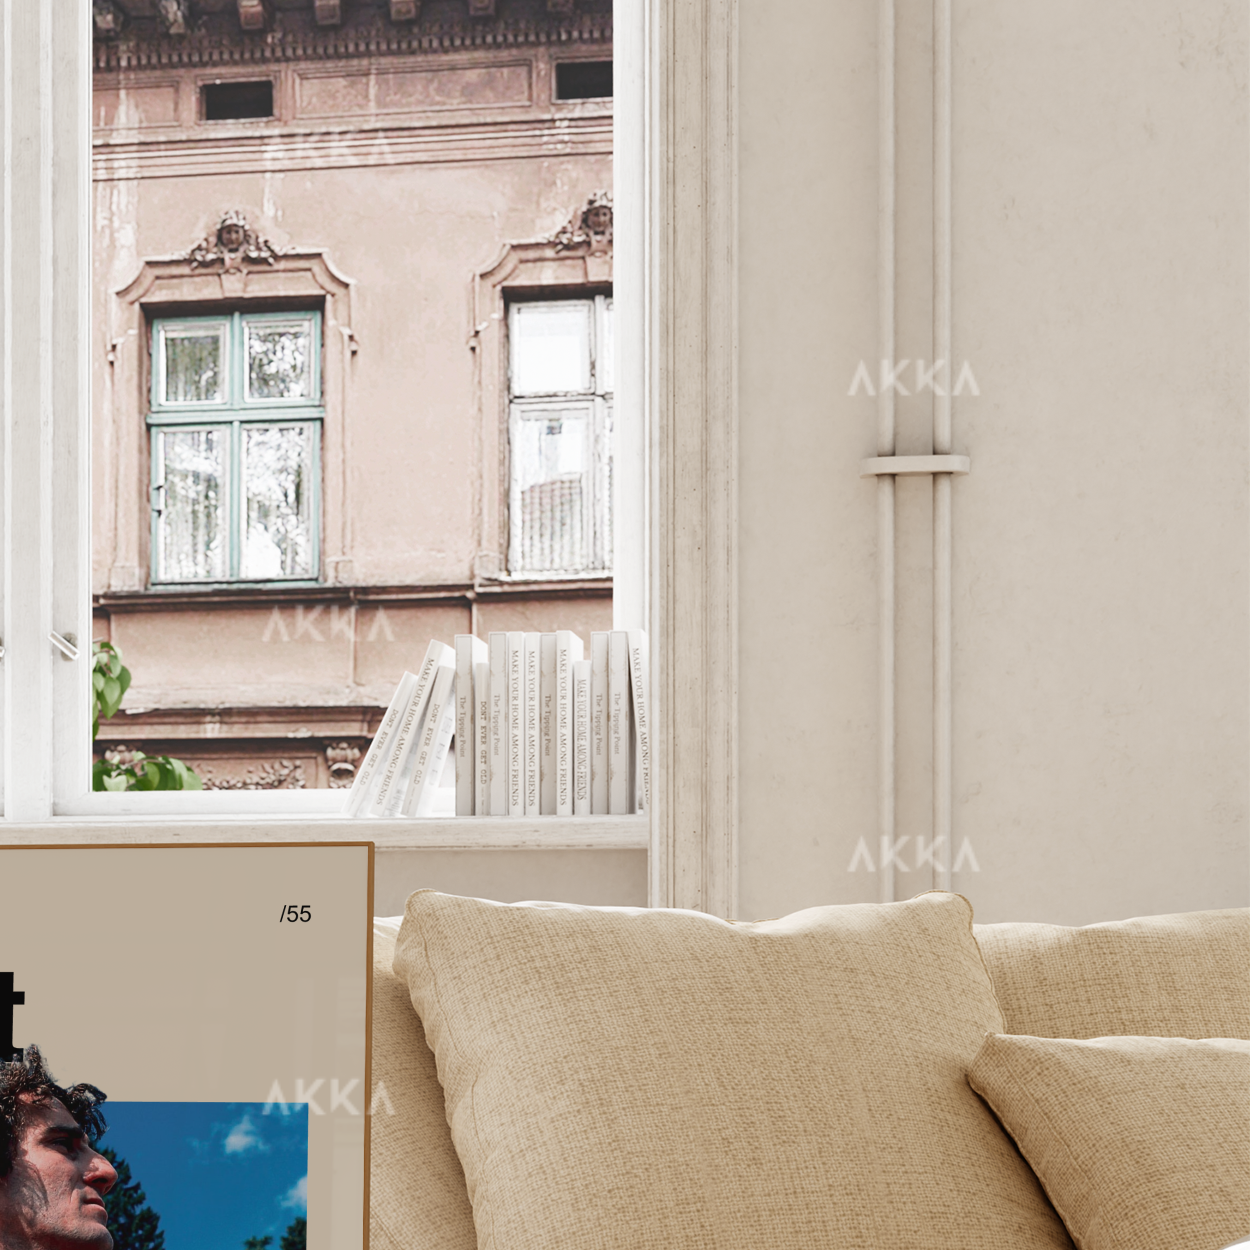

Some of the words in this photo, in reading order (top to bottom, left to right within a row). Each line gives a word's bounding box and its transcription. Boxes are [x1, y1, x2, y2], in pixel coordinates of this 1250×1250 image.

[423, 658, 435, 681] MAKE
[511, 650, 519, 675] MAKE
[412, 682, 426, 706] YOUR
[511, 677, 519, 701] YOUR
[404, 708, 417, 735] HOME
[458, 713, 466, 738] Tipping
[511, 702, 519, 731] HOME
[543, 711, 551, 736] Tipping
[389, 736, 405, 769] AMONG
[511, 733, 519, 767] AMONG
[376, 769, 394, 805] FRIENDS
[511, 769, 519, 807] FRIENDS
[279, 904, 312, 925] /55
